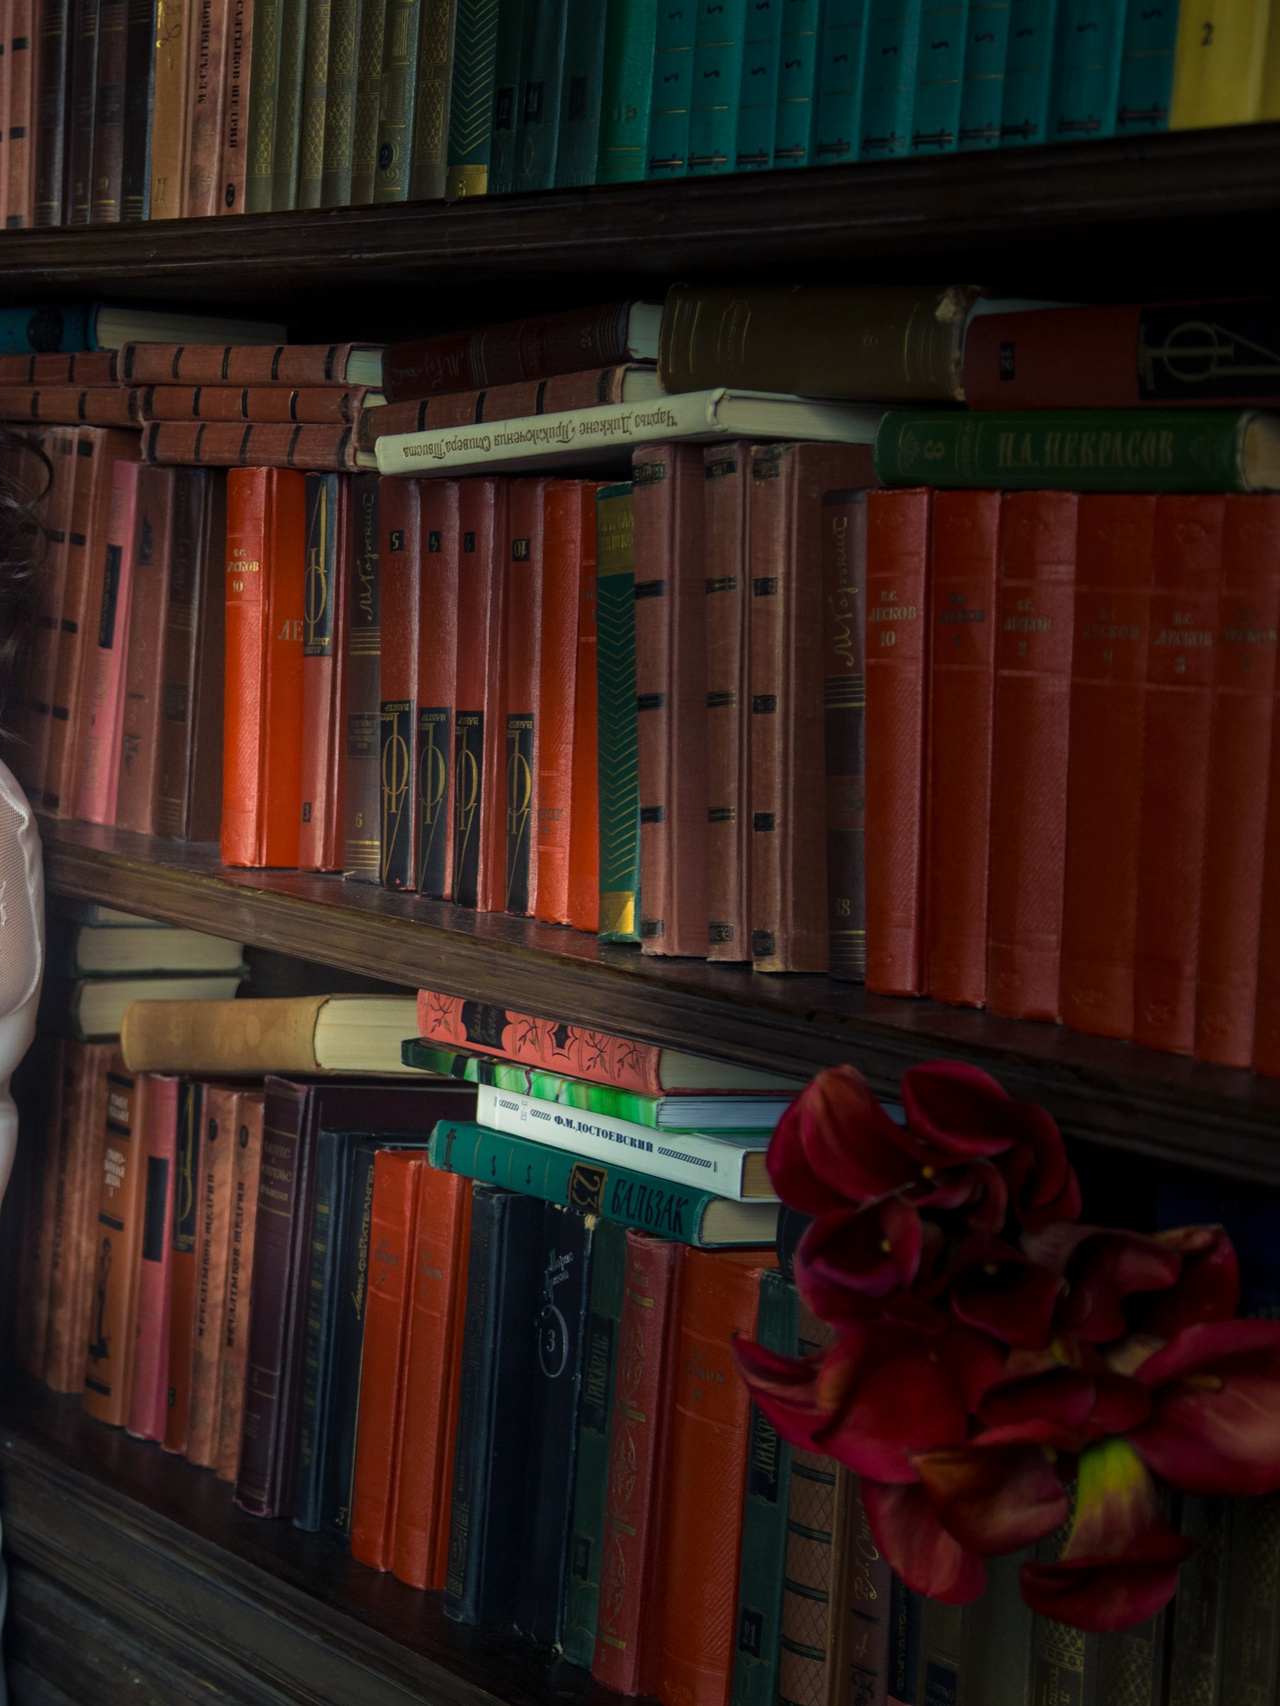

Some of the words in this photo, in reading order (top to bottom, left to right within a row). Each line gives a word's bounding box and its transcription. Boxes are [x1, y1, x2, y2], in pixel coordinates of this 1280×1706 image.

[1201, 23, 1214, 47] 2
[579, 411, 633, 436] Диккенс
[635, 410, 677, 429] Чарльз
[493, 420, 573, 444] Приключения
[402, 438, 447, 460] Твиста
[445, 433, 491, 452] Оливера
[997, 431, 1039, 468] Н.А.
[1043, 430, 1175, 468] НЕКРАСОВ
[391, 532, 399, 549] 5
[513, 540, 528, 557] 10
[869, 605, 917, 622] ЛЕСКОВ
[1005, 616, 1052, 632] ЛЕСКОВ
[1084, 624, 1140, 640] ЛЕСКОВ
[880, 630, 896, 648] 10
[1155, 629, 1213, 648] ЛЕСКОВ
[355, 812, 363, 828] 6
[835, 897, 851, 917] 18
[572, 1168, 600, 1210] 23
[611, 1177, 690, 1237] БАЛЬЗАК
[358, 1164, 375, 1272] ФЕЙХТВАНГЕР
[546, 1329, 556, 1353] 3
[584, 1332, 610, 1416] ДИККЕНС
